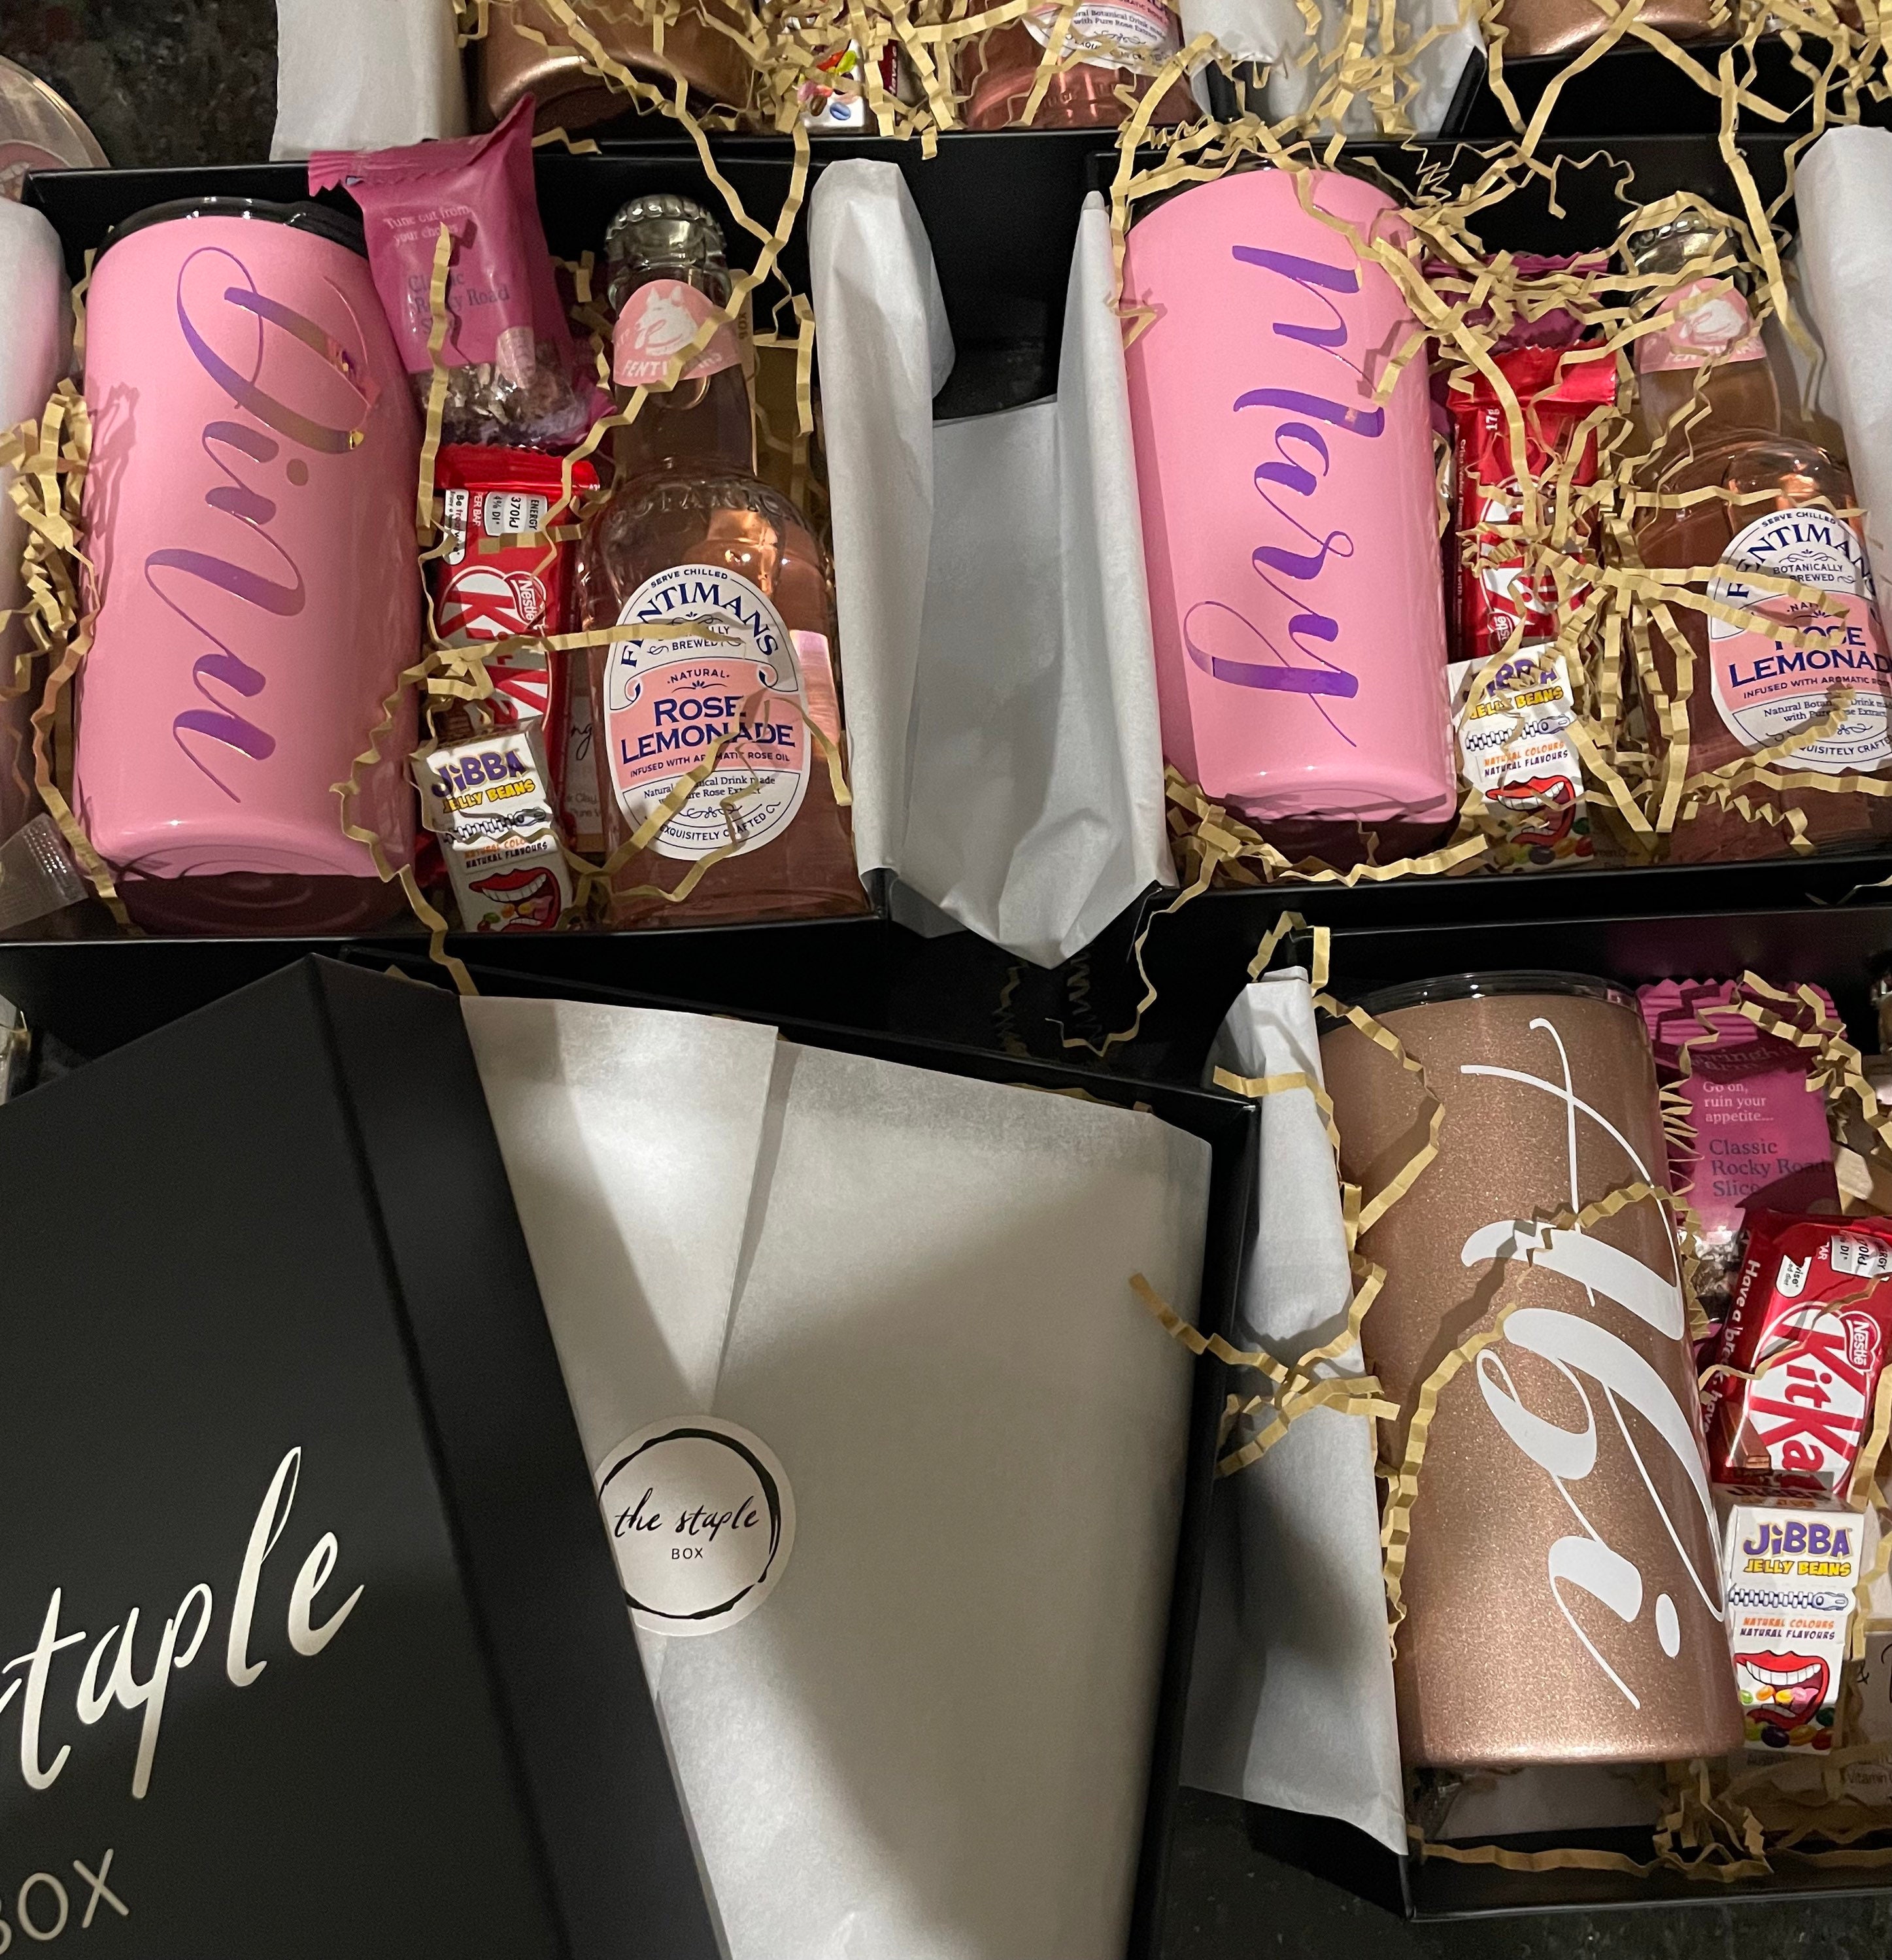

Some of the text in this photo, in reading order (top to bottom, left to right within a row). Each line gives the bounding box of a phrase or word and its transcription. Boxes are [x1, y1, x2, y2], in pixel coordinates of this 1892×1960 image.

[466, 282, 511, 306] Road
[1184, 204, 1385, 749] Mary
[456, 494, 465, 506] Be
[509, 496, 522, 530] 370kJ
[528, 498, 540, 531] ENERGY
[1761, 511, 1837, 528] SERVE CHILLED
[650, 568, 729, 589] SERVE CHILLED
[1772, 563, 1844, 575] BOTANICALLY
[1789, 573, 1835, 583] BREWED
[620, 581, 779, 669] FNTIMANS
[670, 668, 726, 684] NATURAL
[1729, 649, 1892, 688] LEMONAD
[1514, 685, 1564, 709] BEANS
[1743, 682, 1788, 699] INFUSED
[1790, 677, 1818, 687] WITH
[1821, 676, 1870, 684] AROMATIC
[653, 695, 746, 728] ROSE
[1763, 703, 1802, 717] Natural
[1783, 711, 1807, 722] with
[1525, 741, 1565, 759] COLOURS
[630, 761, 664, 778] INFUSED
[666, 755, 690, 768] WITH
[747, 751, 773, 760] ROSE
[1484, 750, 1569, 777] NATURAL FLAVOURS
[443, 779, 537, 814] JELLY BEANS
[643, 783, 675, 798] Natural
[720, 775, 747, 785] Drink
[703, 786, 726, 798] Rose
[660, 813, 767, 841] EXQUISITELY CAFTED
[465, 841, 549, 869] NATURAL FLAVOURS
[1702, 1081, 1748, 1094] Go on,
[1704, 1096, 1767, 1113] ruin your
[1709, 1138, 1779, 1155] Classic
[1712, 1158, 1827, 1177] Rocky Road
[1712, 1179, 1763, 1198] Slice
[1817, 1244, 1829, 1260] AR
[1736, 1259, 1761, 1308] Have
[1731, 1309, 1742, 1322] a
[1749, 1323, 1867, 1472] KitKa
[613, 1487, 760, 1542] the staple
[1742, 1519, 1853, 1559] JiBBA
[671, 1547, 704, 1561] BOX
[1743, 1558, 1852, 1577] JELLY BEANS
[0, 1445, 365, 1800] taple
[1742, 1617, 1834, 1629] NATURAL COLOURS
[1739, 1627, 1836, 1640] NATURAL FLAVOURS
